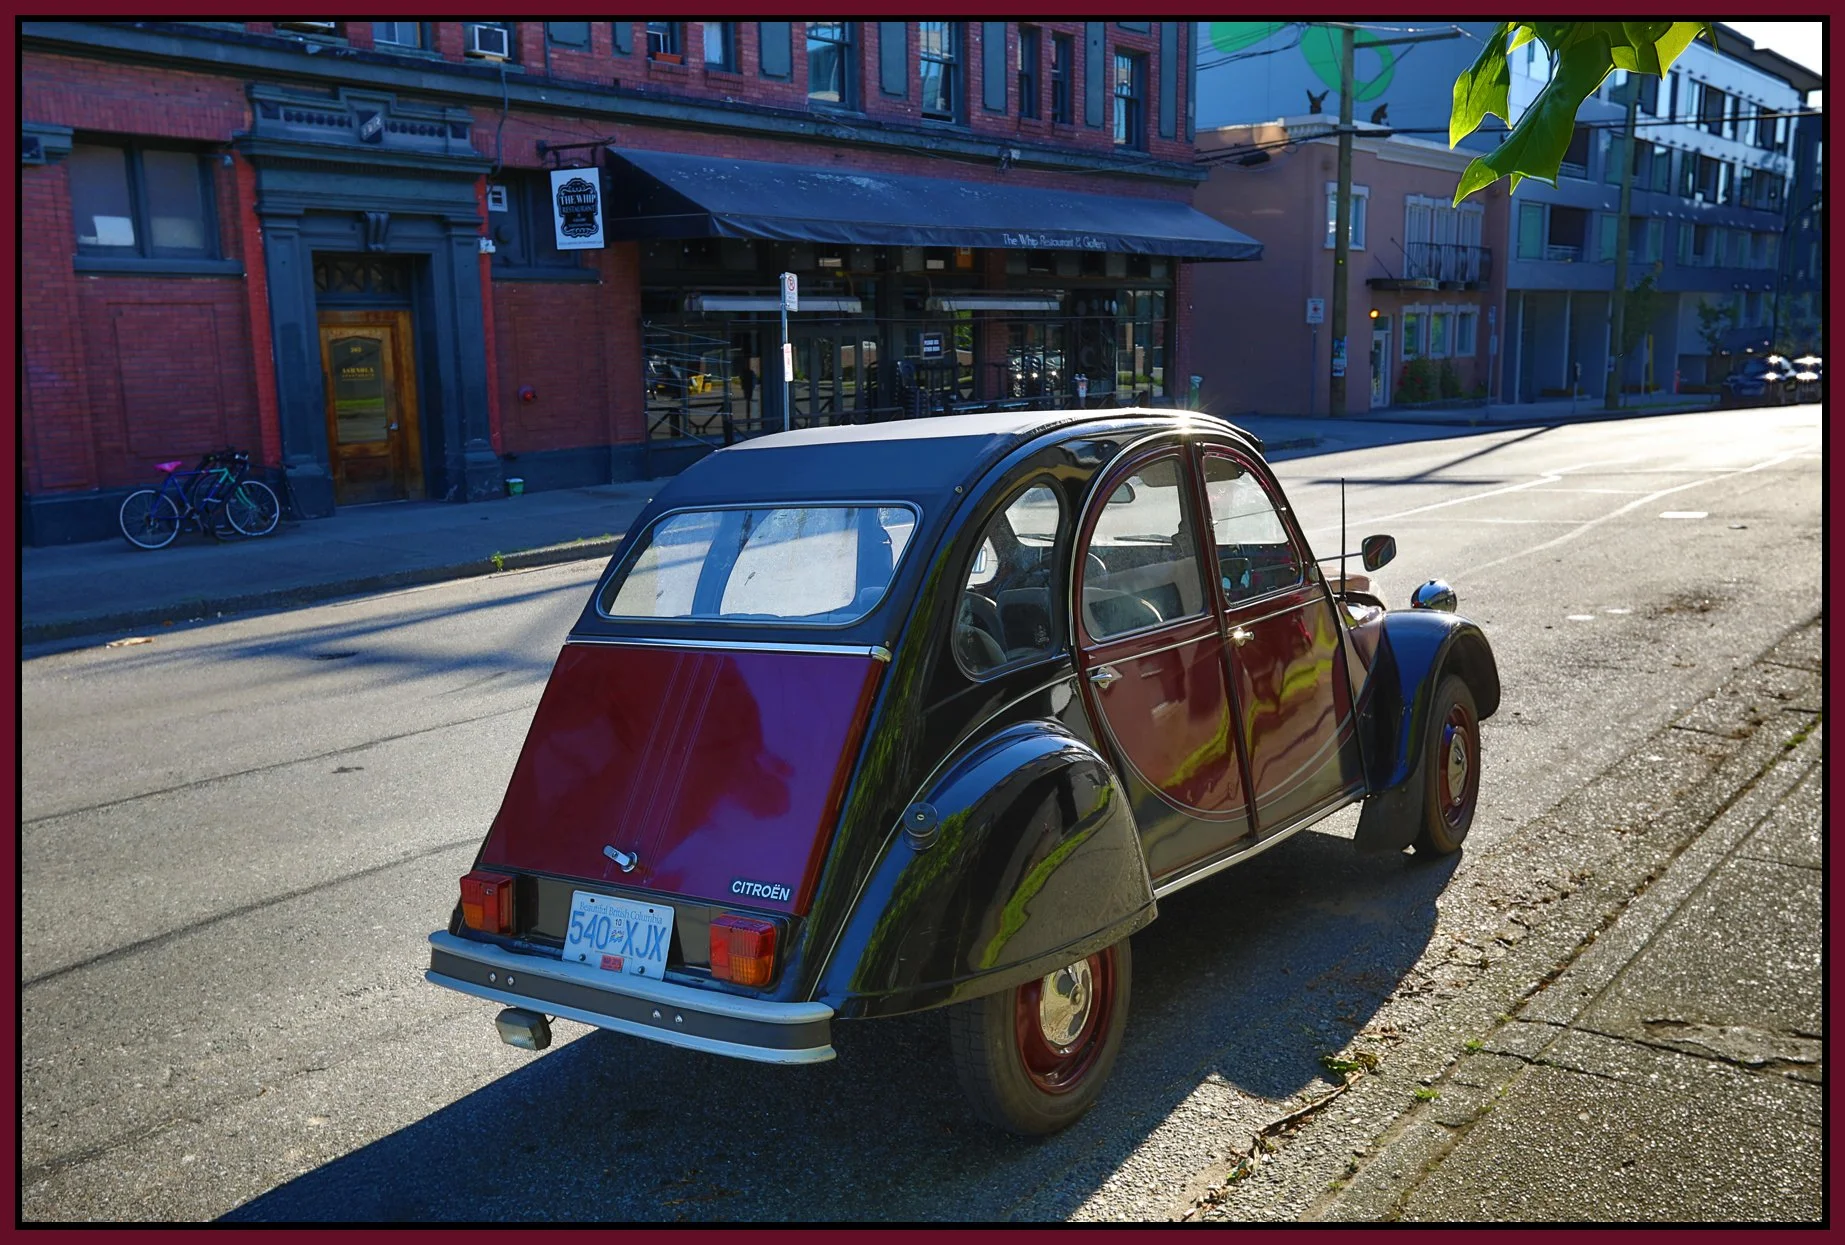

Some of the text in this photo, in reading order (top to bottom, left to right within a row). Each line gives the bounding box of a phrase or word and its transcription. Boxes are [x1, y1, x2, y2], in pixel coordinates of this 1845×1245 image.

[560, 194, 596, 205] THE WHIP
[562, 205, 595, 214] RESTAURANT
[1002, 233, 1017, 246] The
[1018, 233, 1039, 248] Whip
[1039, 234, 1074, 247] Restaurant
[1082, 236, 1107, 250] Gallery
[732, 880, 790, 901] CITROËN
[579, 901, 663, 925] Beautiful British Columbia
[569, 910, 667, 962] 540 XJX
